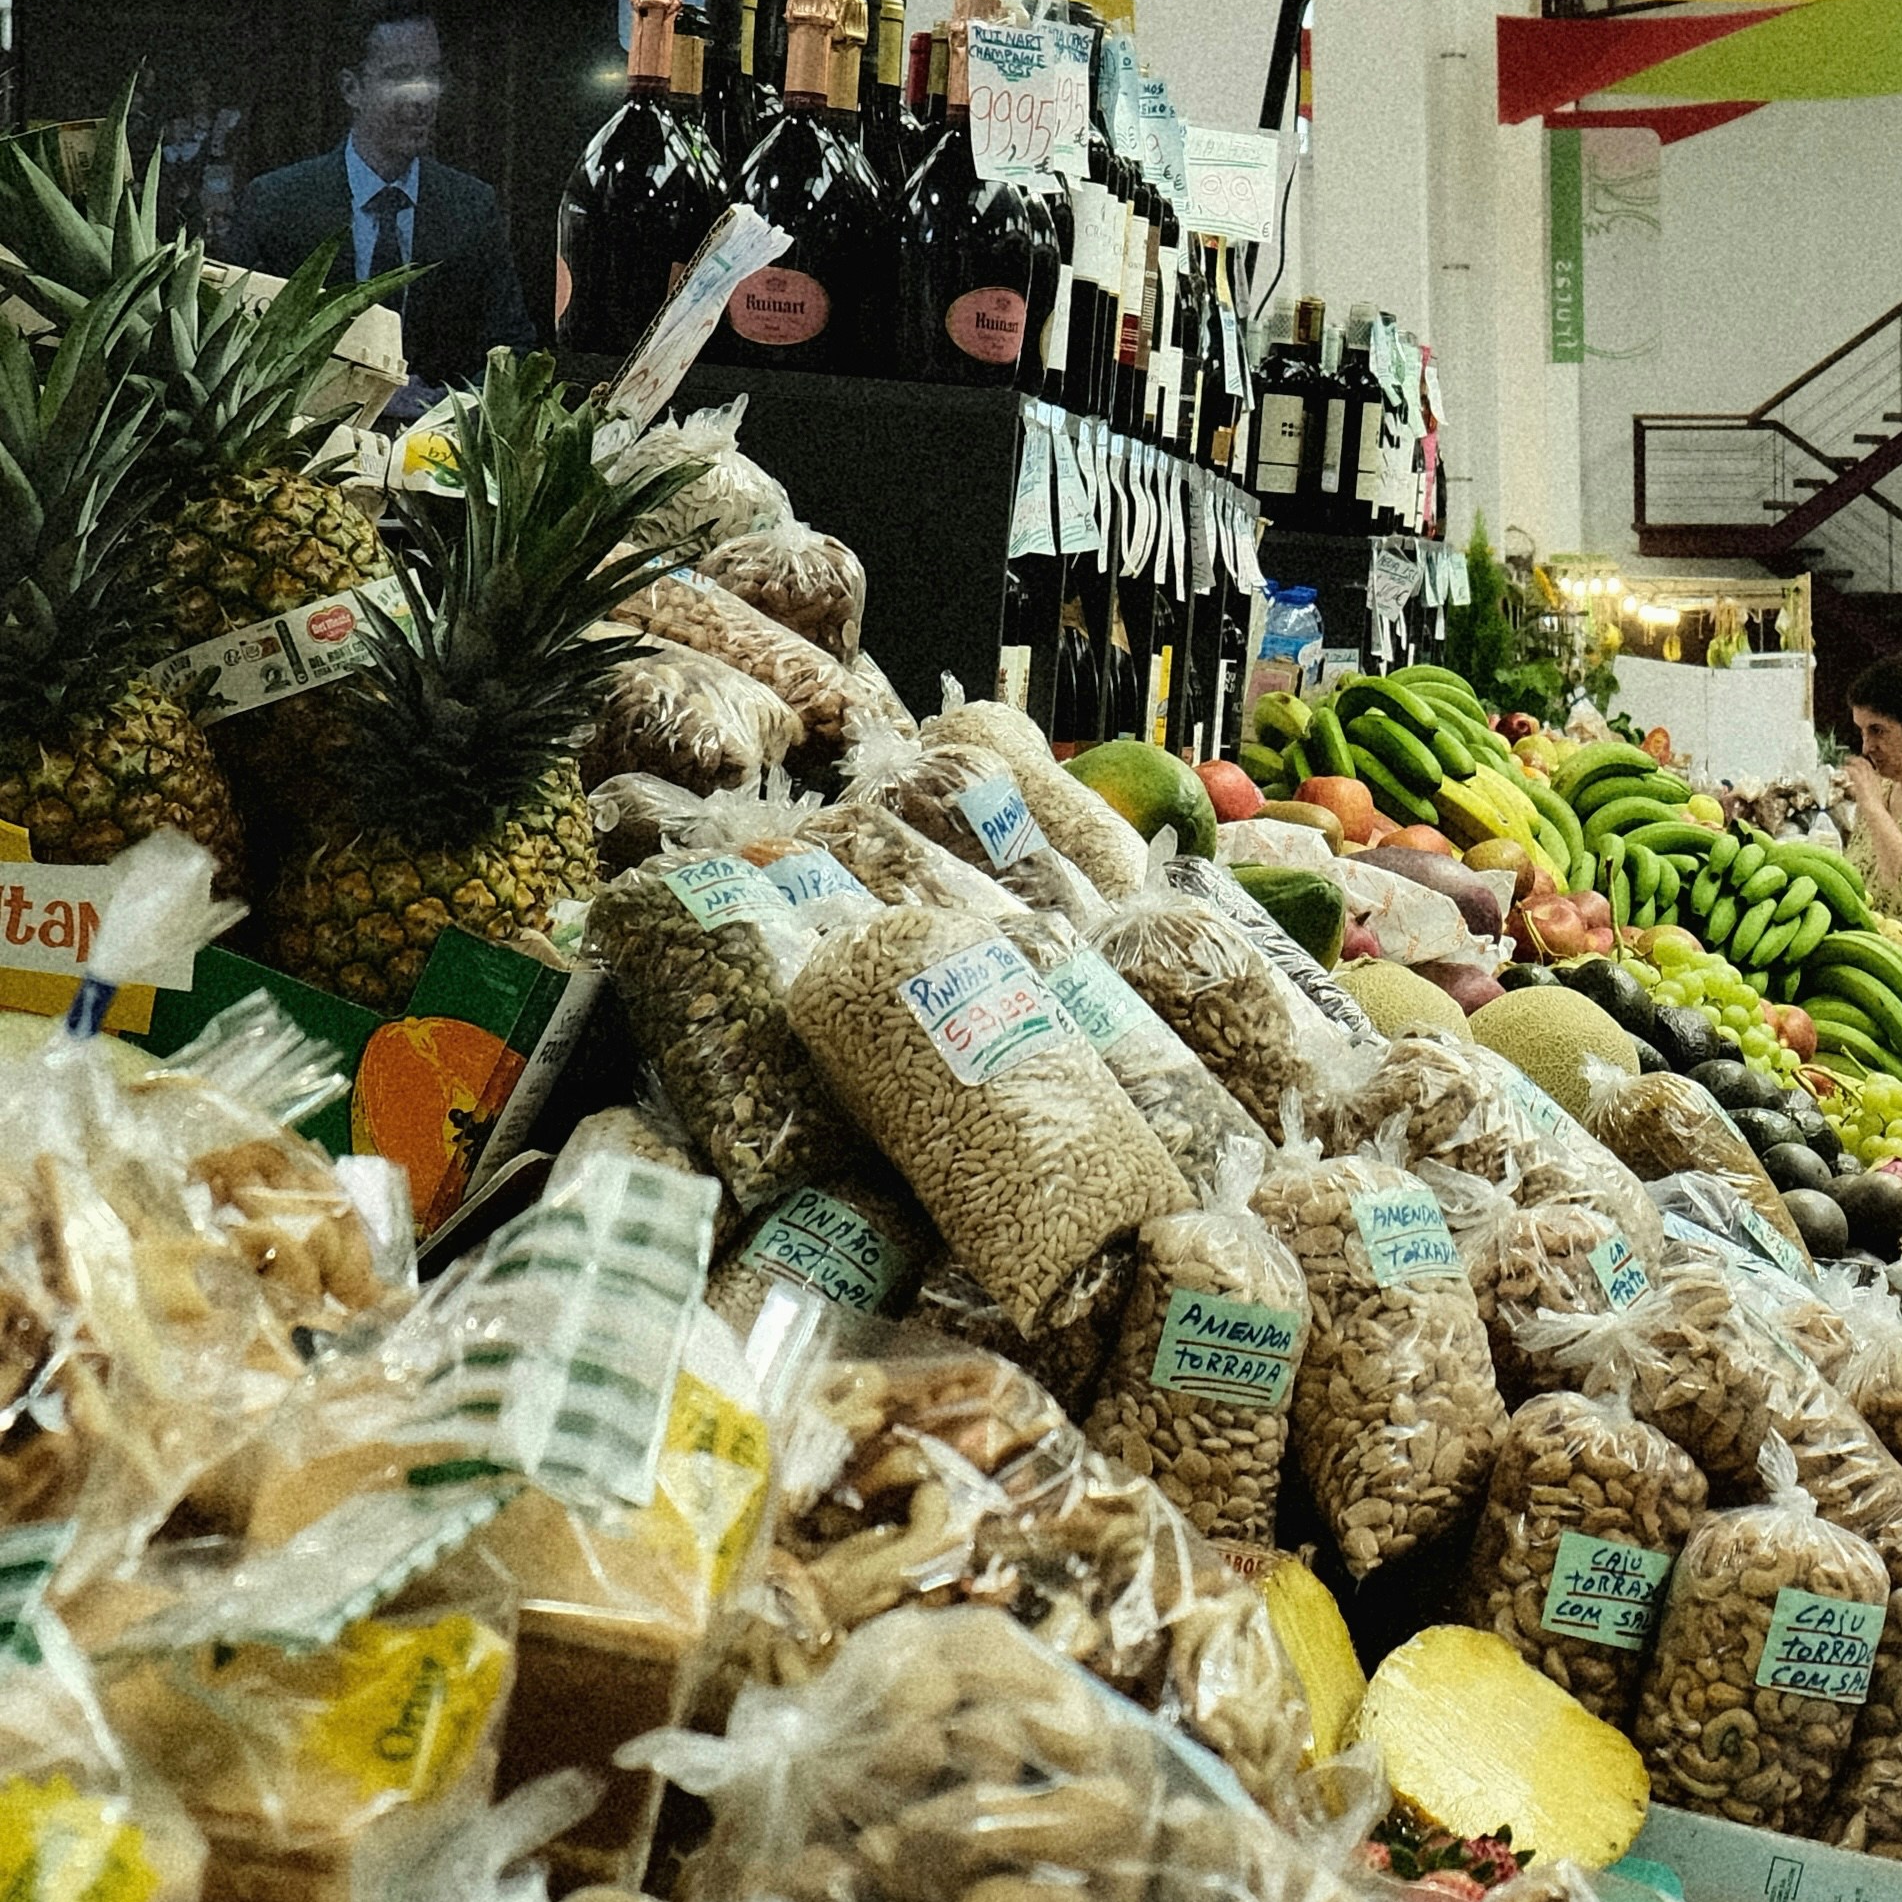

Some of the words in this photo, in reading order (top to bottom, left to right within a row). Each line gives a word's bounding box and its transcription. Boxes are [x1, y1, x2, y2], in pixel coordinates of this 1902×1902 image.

[970, 85, 1054, 163] 99,95
[746, 293, 806, 315] Ruinart
[1178, 1302, 1292, 1352] AMENDOA
[1555, 1600, 1603, 1624] COM
[1613, 1610, 1651, 1630] SAL
[1771, 1665, 1831, 1691] COM
[1830, 1670, 1869, 1693] SAL
